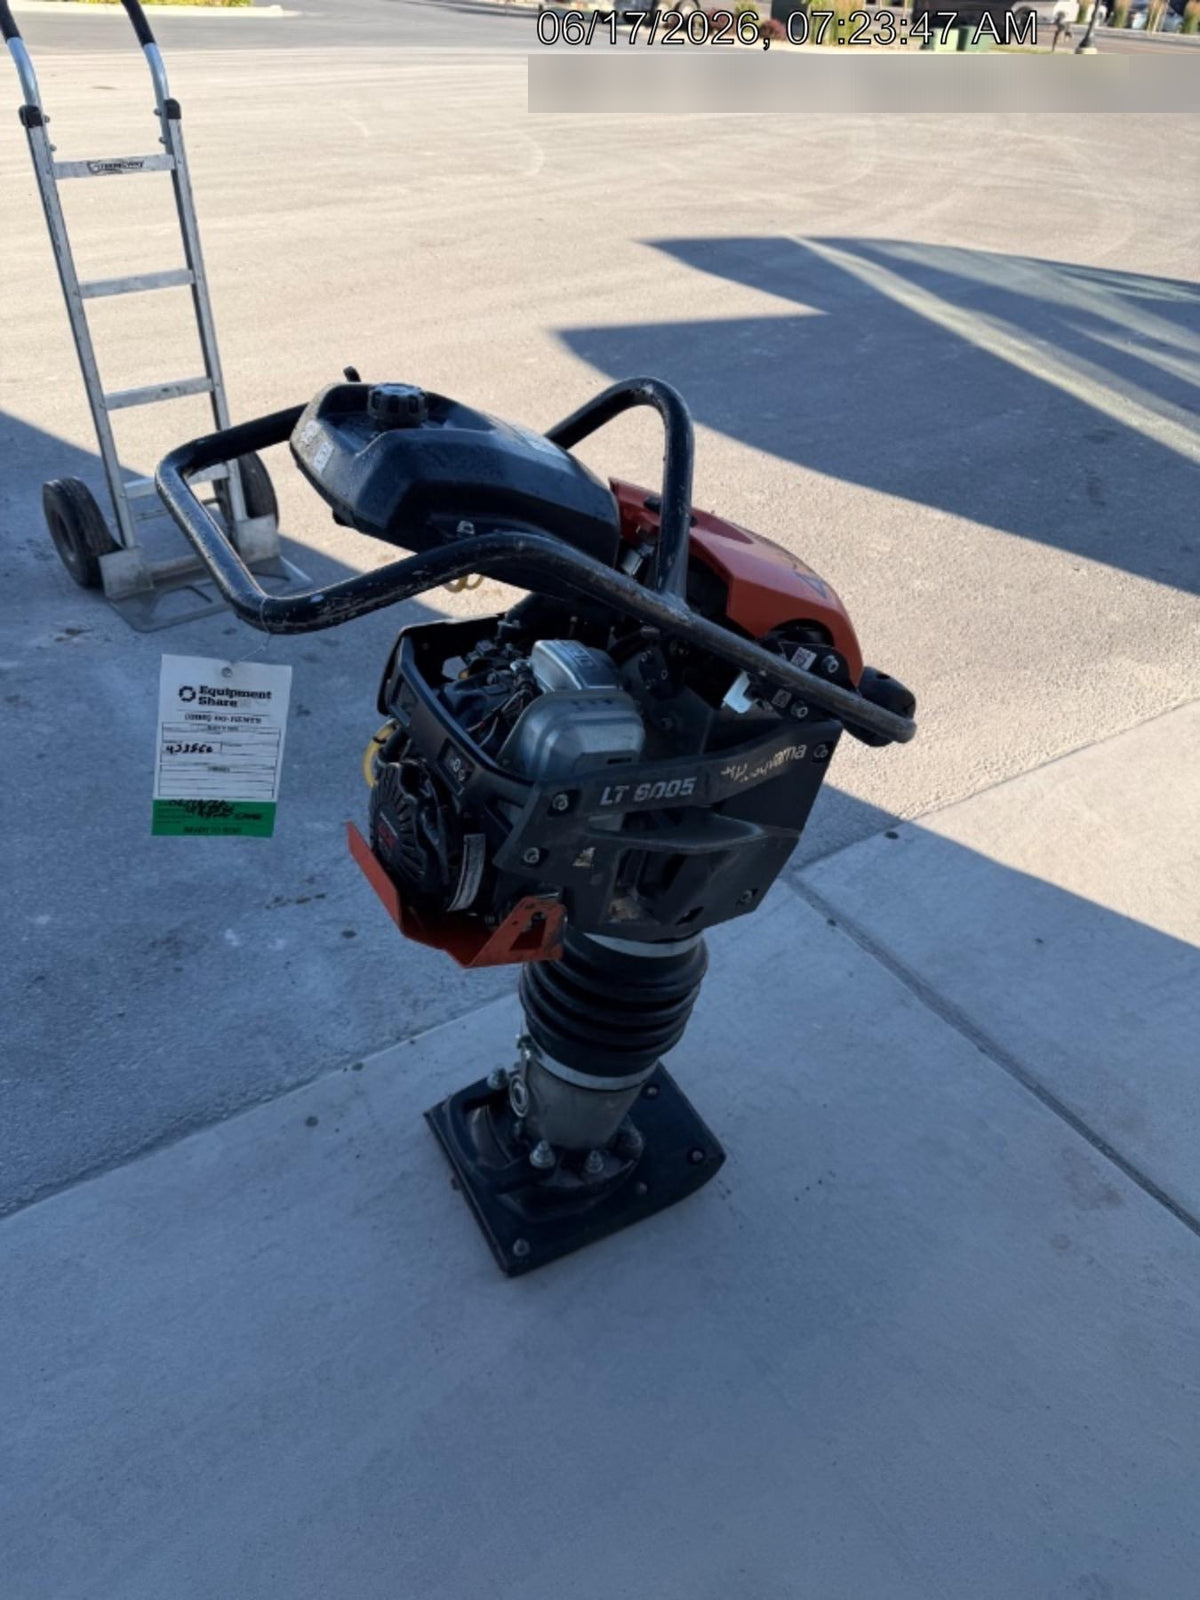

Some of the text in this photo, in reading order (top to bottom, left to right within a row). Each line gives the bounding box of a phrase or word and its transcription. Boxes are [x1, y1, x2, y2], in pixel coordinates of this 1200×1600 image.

[199, 685, 272, 699] Equipment
[198, 696, 238, 707] Share
[599, 776, 698, 806] LT 6005
